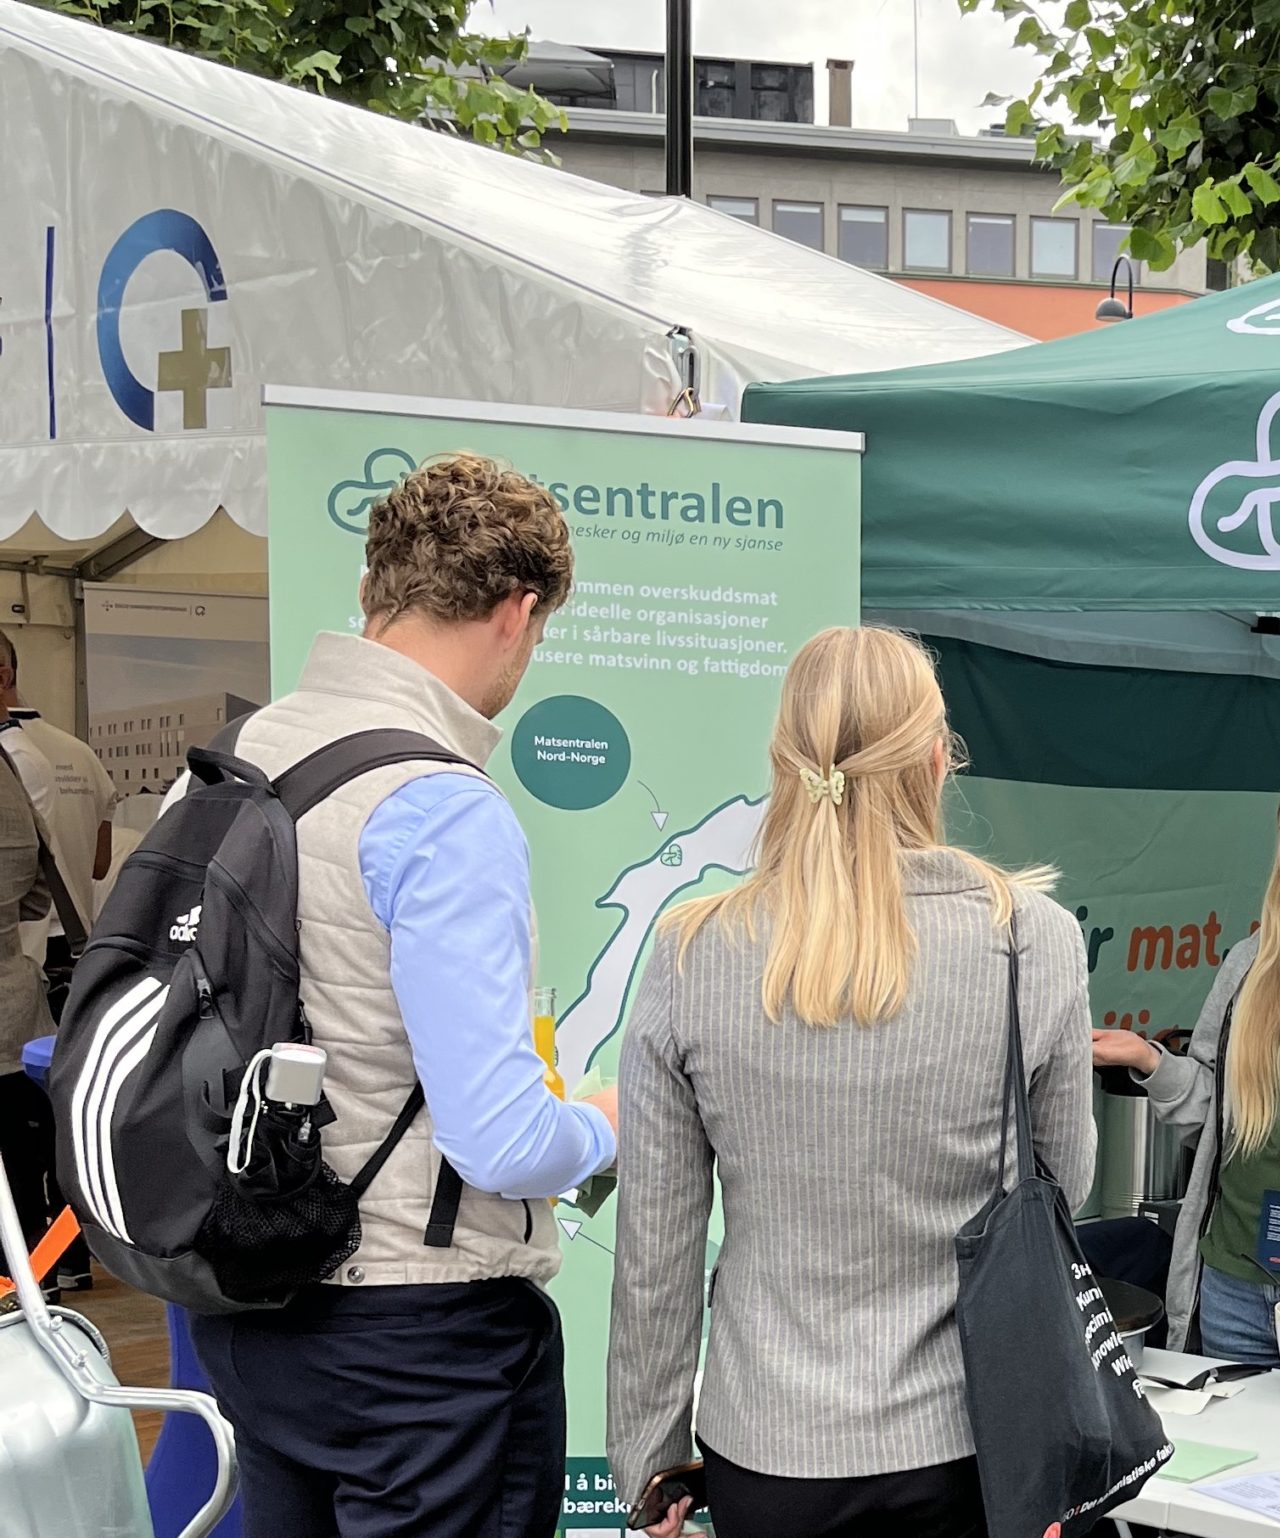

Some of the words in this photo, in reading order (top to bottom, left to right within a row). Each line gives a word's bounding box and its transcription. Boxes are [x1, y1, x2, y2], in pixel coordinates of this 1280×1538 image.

[529, 474, 784, 529] sentralen
[569, 523, 617, 540] esker
[621, 530, 641, 544] og
[646, 528, 685, 546] miljø
[689, 535, 708, 547] en
[713, 536, 732, 550] ny
[735, 535, 783, 552] sjanse
[571, 580, 634, 596] mmen
[639, 583, 779, 606] overskuddsmat
[571, 601, 632, 620] ideelle
[636, 607, 768, 629] organisasjoner
[583, 625, 652, 646] sårbare
[656, 631, 788, 654] livssituasjoner.
[532, 650, 584, 665] usere
[589, 653, 672, 671] matsvinn
[677, 659, 699, 675] og
[534, 735, 608, 750] Matsentralen
[537, 750, 606, 765] Nord-Norge
[563, 1497, 631, 1514] bærek
